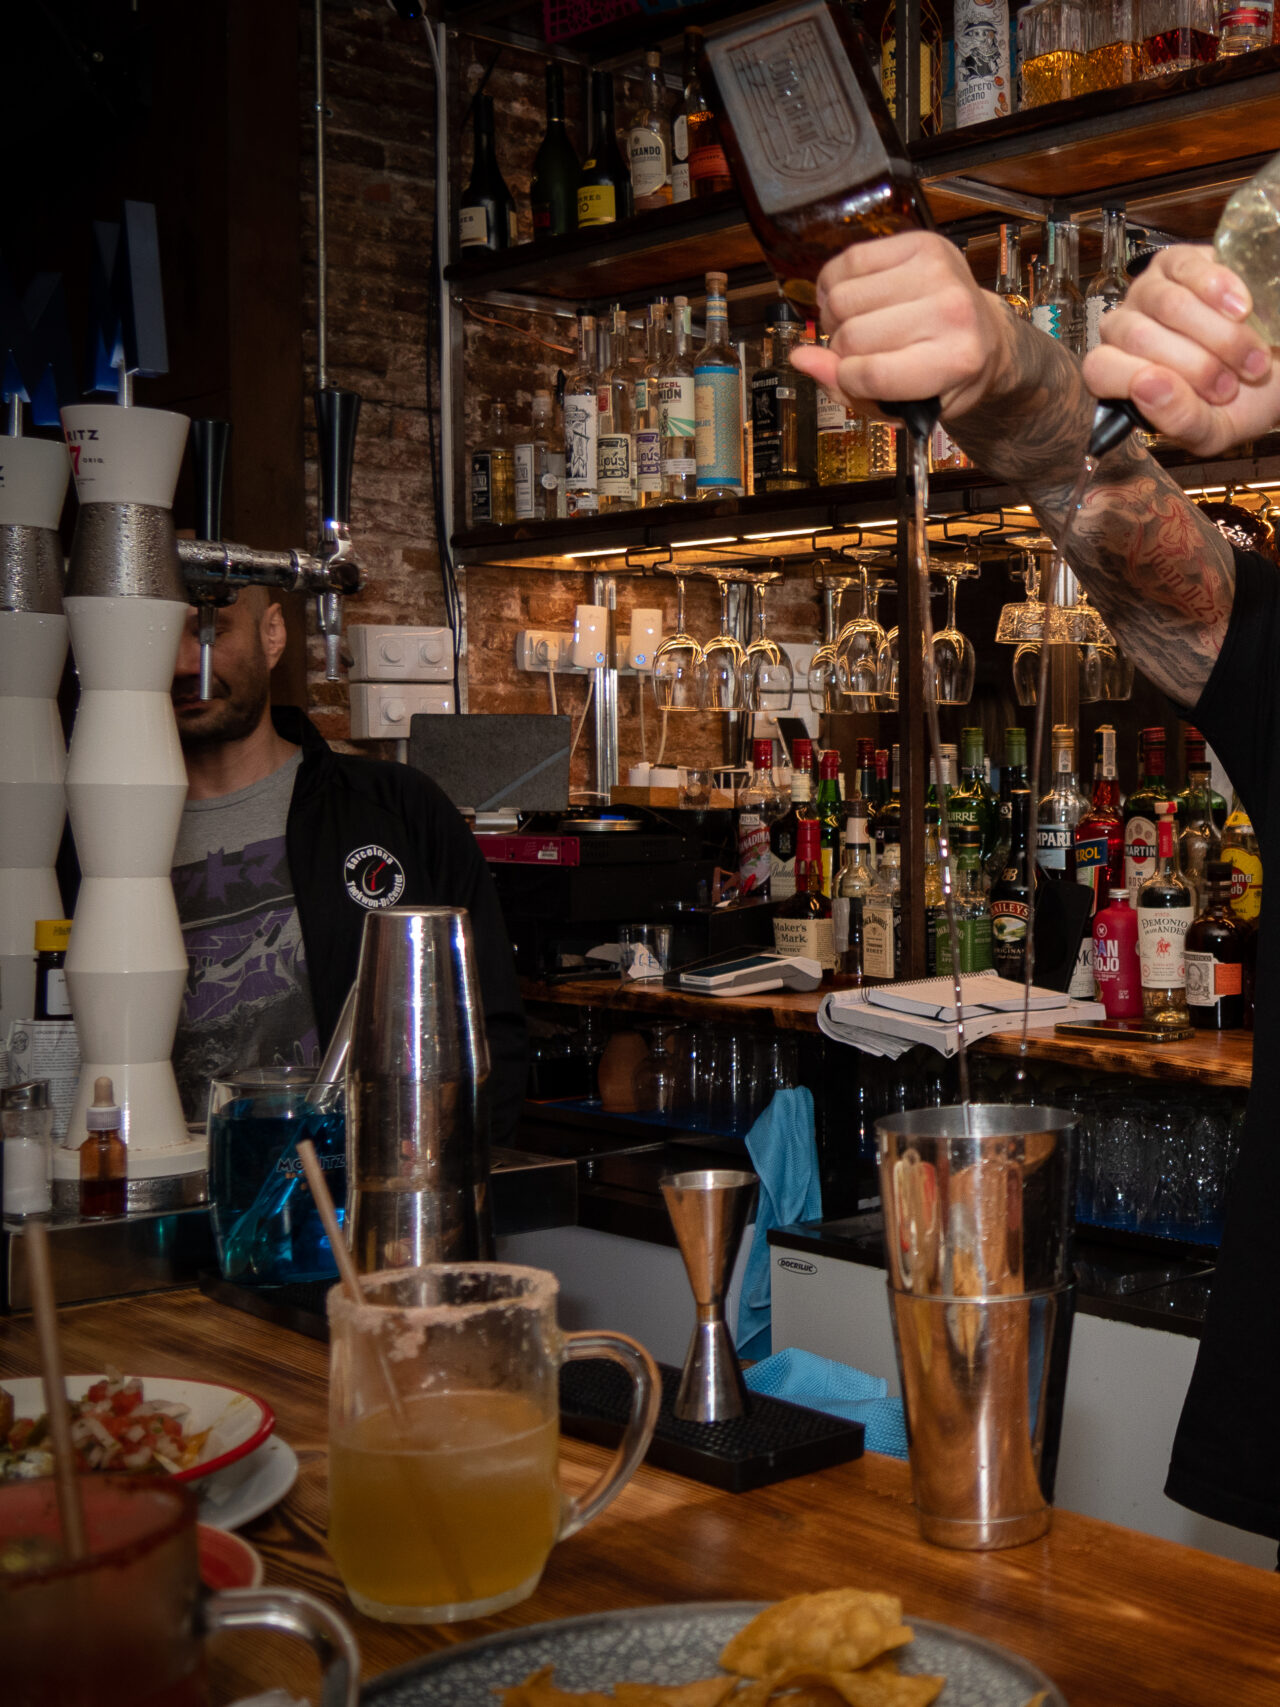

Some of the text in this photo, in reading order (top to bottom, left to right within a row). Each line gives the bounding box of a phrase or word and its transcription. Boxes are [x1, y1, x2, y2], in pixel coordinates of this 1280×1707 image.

[658, 388, 682, 400] NIÓN
[66, 430, 99, 441] RITZ
[1143, 544, 1225, 625] Juan 11:25
[947, 811, 978, 822] UIRRE
[1037, 832, 1071, 846] MPARI
[1075, 847, 1100, 862] EROL
[1126, 846, 1157, 857] MARTIN
[347, 847, 394, 870] Barcelona
[774, 922, 807, 932] Maker's
[1157, 927, 1186, 936] ANDES
[276, 1153, 346, 1172] MOITZ
